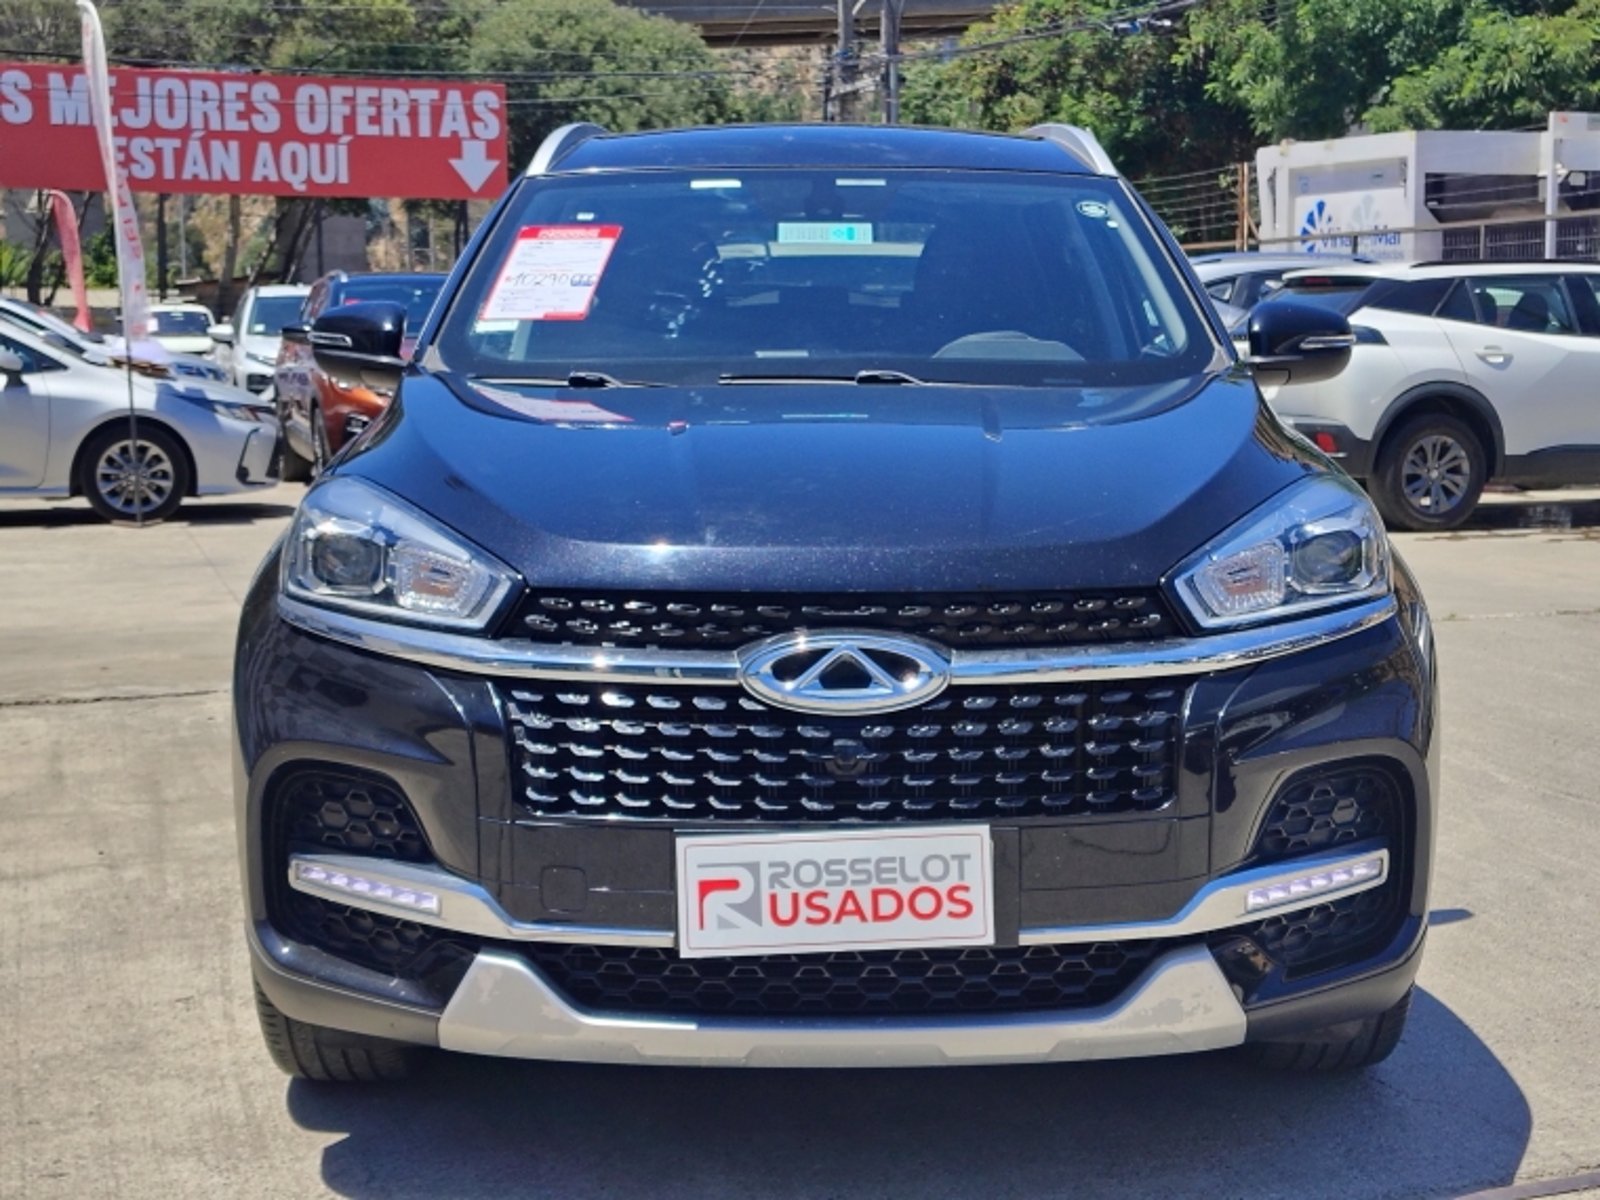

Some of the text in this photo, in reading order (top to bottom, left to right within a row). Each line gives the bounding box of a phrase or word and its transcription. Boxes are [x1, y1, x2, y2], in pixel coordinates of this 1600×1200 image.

[295, 83, 500, 140] OFERTAS
[252, 135, 353, 192] AQUÍ
[768, 854, 971, 889] ROSSELOT
[768, 884, 974, 927] USADOS
